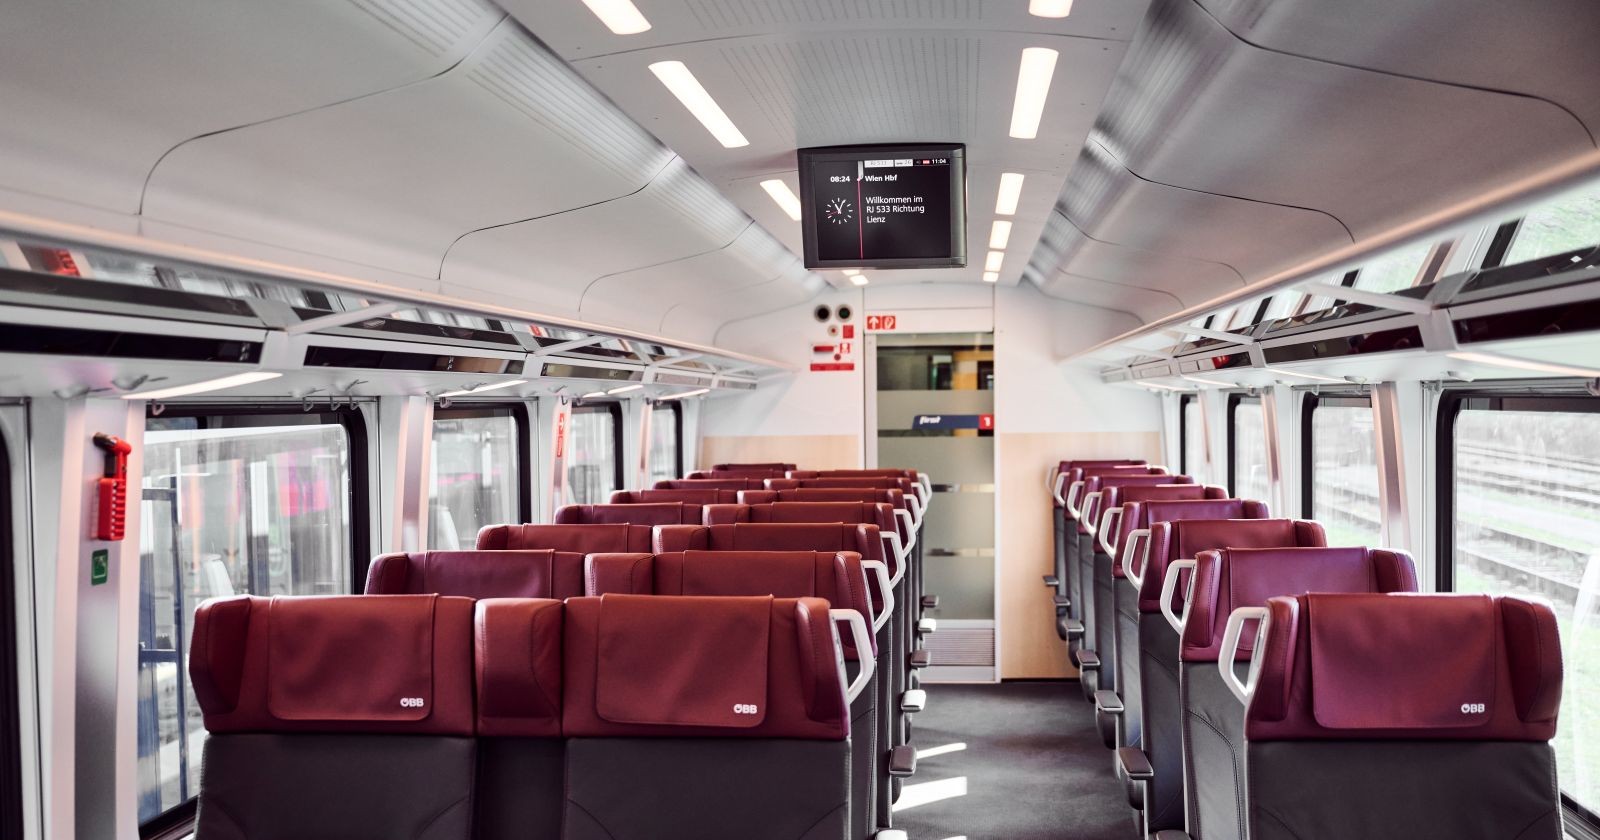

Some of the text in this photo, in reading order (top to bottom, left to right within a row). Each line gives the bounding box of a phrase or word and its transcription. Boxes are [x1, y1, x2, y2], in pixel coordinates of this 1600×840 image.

[830, 175, 850, 183] 08:24
[865, 195, 923, 204] Willkommen im
[866, 204, 925, 214] RJ 533 Richtung
[866, 215, 886, 223] Lienz
[984, 417, 991, 426] 1
